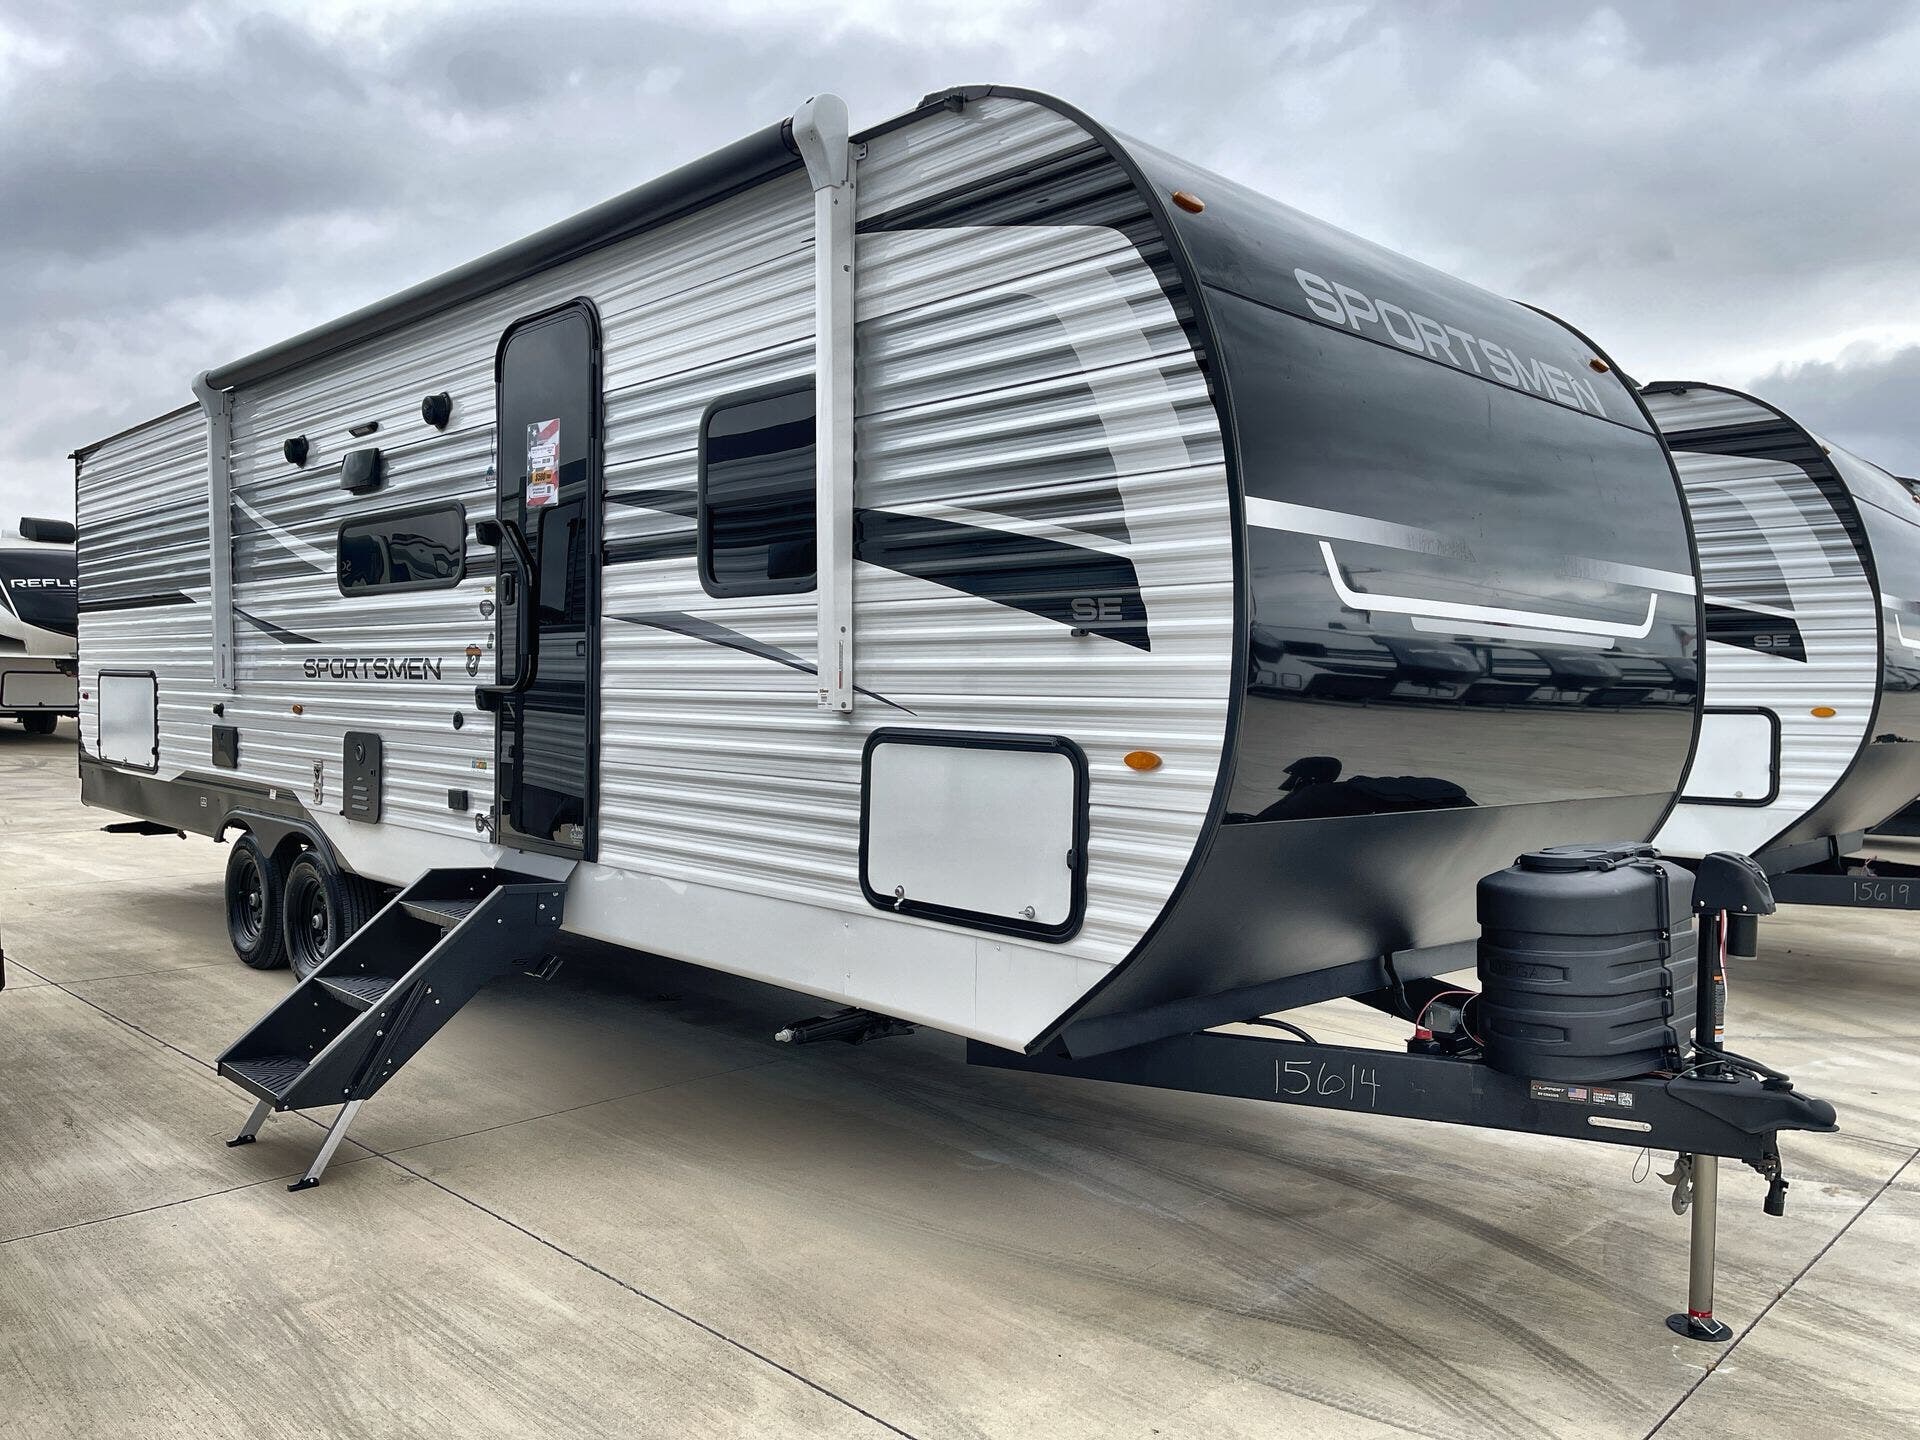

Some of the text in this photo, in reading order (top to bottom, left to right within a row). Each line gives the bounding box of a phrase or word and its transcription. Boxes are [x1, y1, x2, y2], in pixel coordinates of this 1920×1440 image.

[1293, 268, 1608, 418] SPORTSMEN
[1071, 597, 1123, 621] SE
[1753, 634, 1791, 647] SE
[303, 657, 443, 680] SPORTSMEN
[1853, 882, 1910, 905] 15619
[1274, 1059, 1382, 1108] 15614
